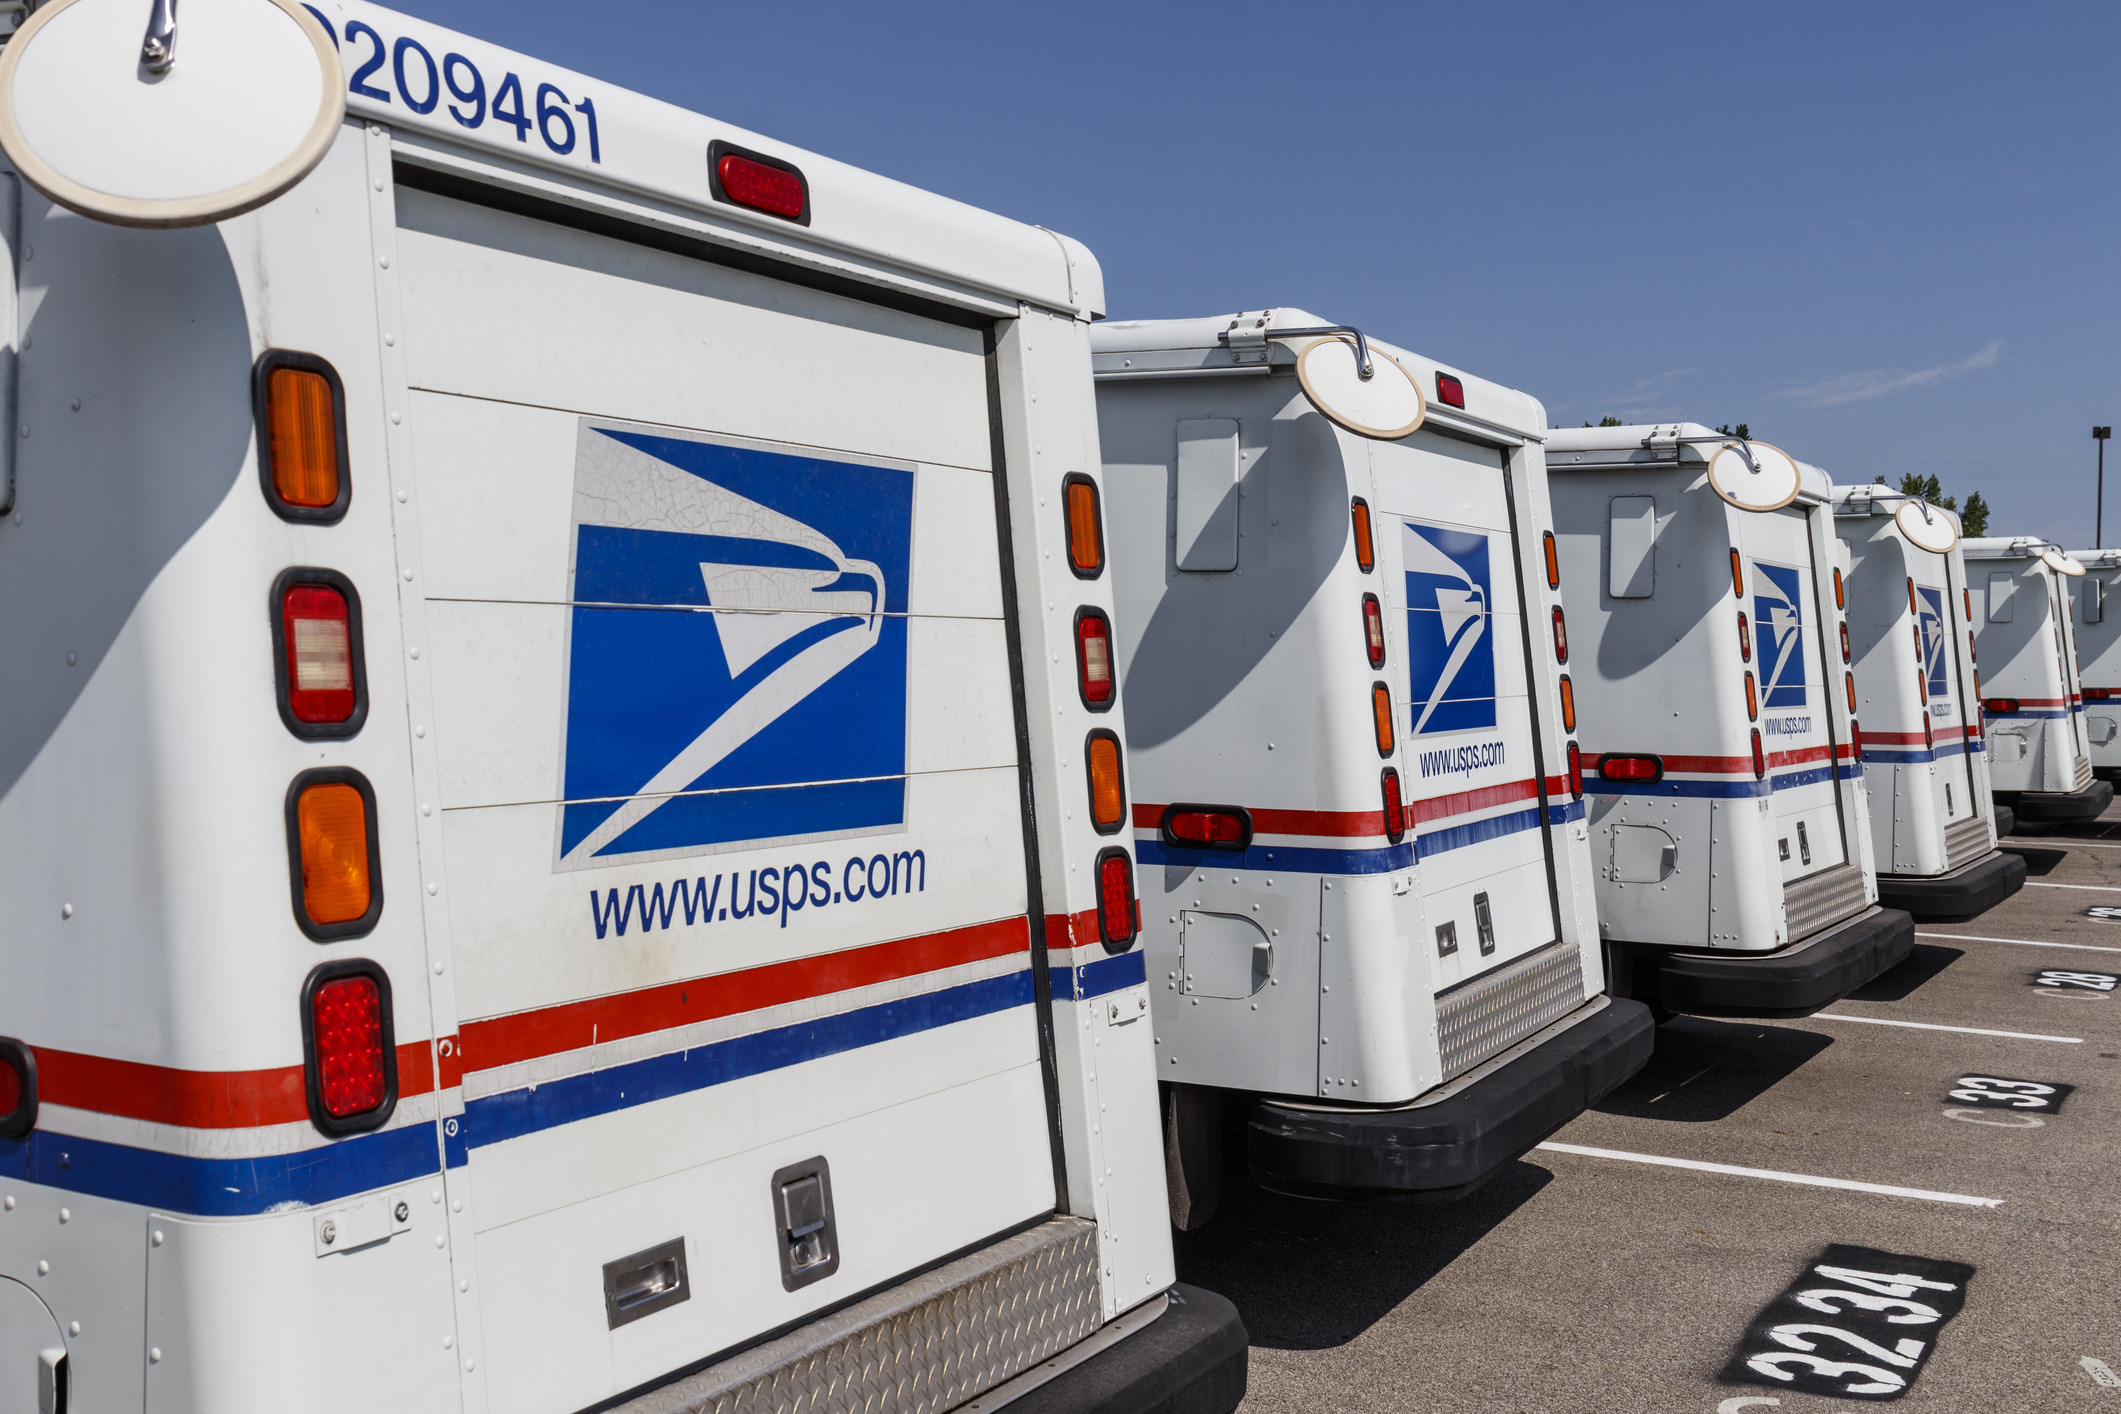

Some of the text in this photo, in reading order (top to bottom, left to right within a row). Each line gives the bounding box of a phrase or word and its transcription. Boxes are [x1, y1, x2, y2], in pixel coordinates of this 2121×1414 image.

[301, 3, 601, 165] 209461
[1764, 716, 1812, 740] www.usps.com
[1419, 741, 1505, 779] www.usps.com
[590, 849, 925, 940] www.usps.com
[2036, 971, 2117, 991] 28
[1949, 1077, 2056, 1107] 33
[1746, 1264, 1958, 1394] 3234
